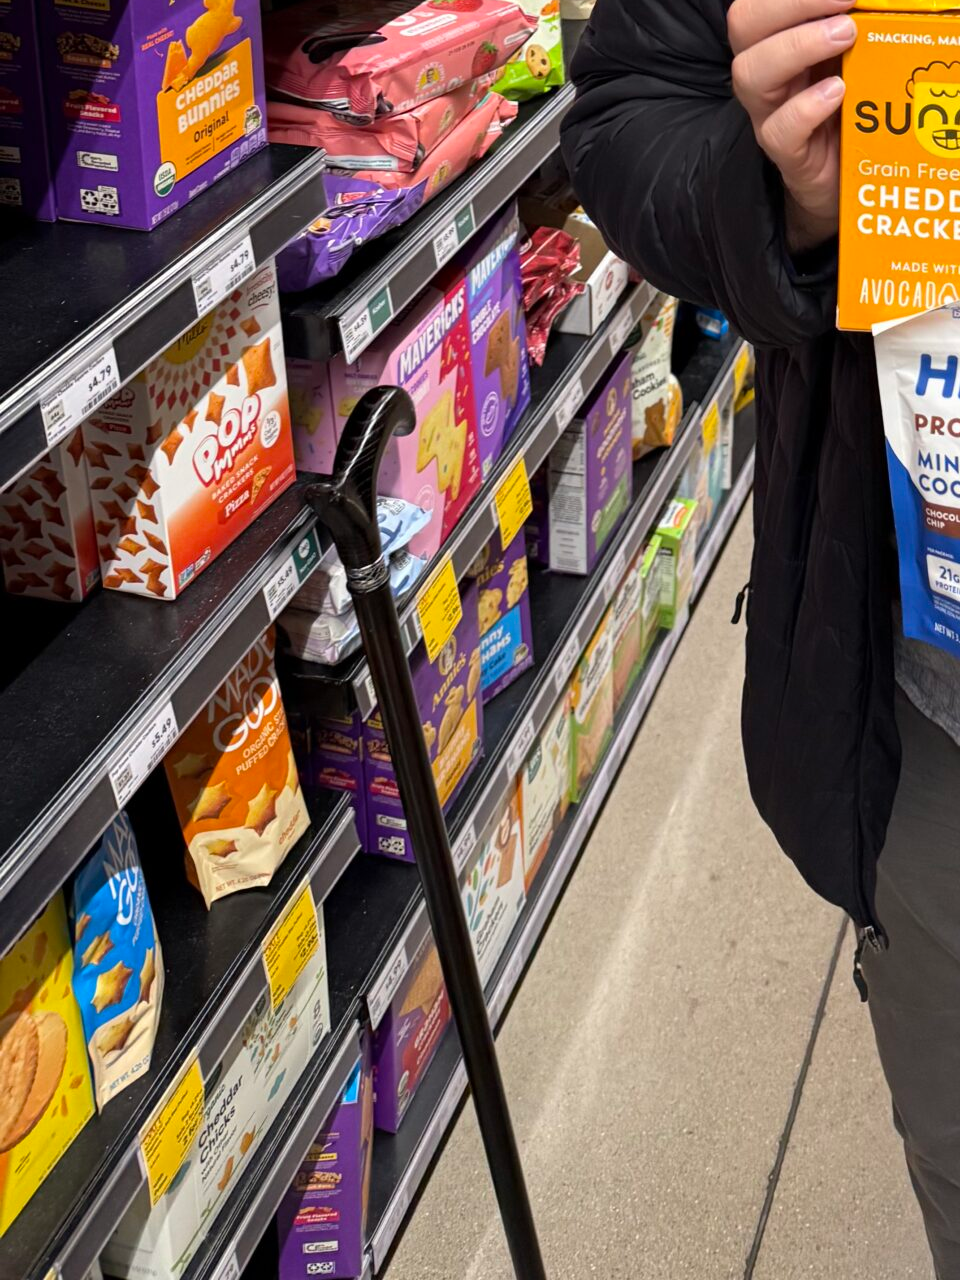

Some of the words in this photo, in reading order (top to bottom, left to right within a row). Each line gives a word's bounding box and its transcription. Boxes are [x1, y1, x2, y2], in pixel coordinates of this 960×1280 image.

[867, 32, 935, 46] SNACKING,
[193, 110, 230, 143] Original
[858, 159, 910, 179] Grain
[917, 163, 960, 182] Free
[229, 249, 250, 273] $4.79
[891, 261, 928, 273] MADE
[400, 290, 465, 385] MAVERICKS
[88, 364, 112, 393] $4.79
[223, 489, 250, 518] Pizza
[926, 517, 945, 529] CHIP
[939, 565, 960, 584] 21G
[934, 622, 945, 636] NET
[945, 628, 955, 641] WT
[151, 716, 173, 749] $5.49
[235, 745, 270, 776] PUFFED
[198, 1074, 244, 1149] Cheddar
[200, 1106, 236, 1164] Chicks
